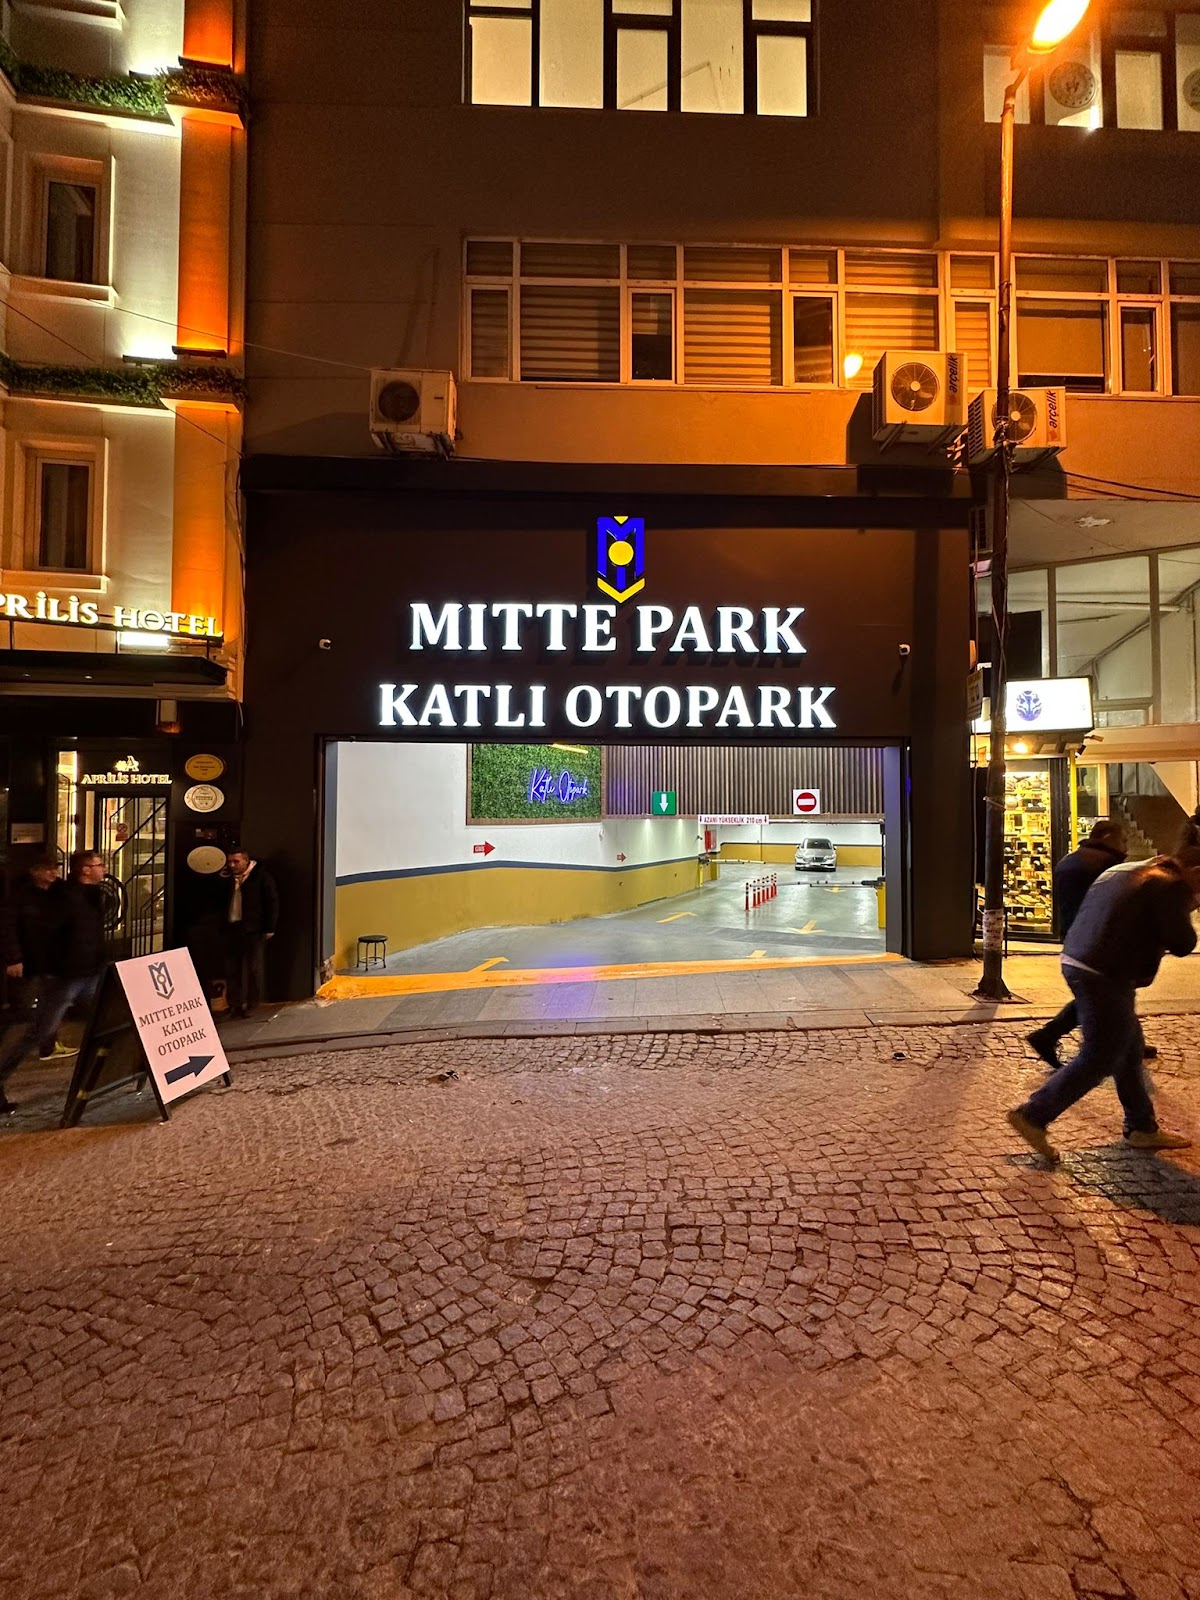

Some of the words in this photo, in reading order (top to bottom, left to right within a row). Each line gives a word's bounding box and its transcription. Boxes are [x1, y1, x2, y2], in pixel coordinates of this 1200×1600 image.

[948, 355, 960, 393] arçelik
[1046, 390, 1059, 429] arçelik
[113, 605, 224, 638] HOTEL
[408, 603, 617, 652] MITTE
[636, 604, 807, 654] PARK
[378, 682, 548, 728] KATLI
[563, 684, 838, 729] OTOPARK
[130, 774, 173, 785] HOTEL
[138, 1006, 176, 1027] MITTE
[176, 997, 203, 1015] PARK
[162, 1016, 193, 1037] KATLI
[158, 1028, 207, 1056] OTOPARK
